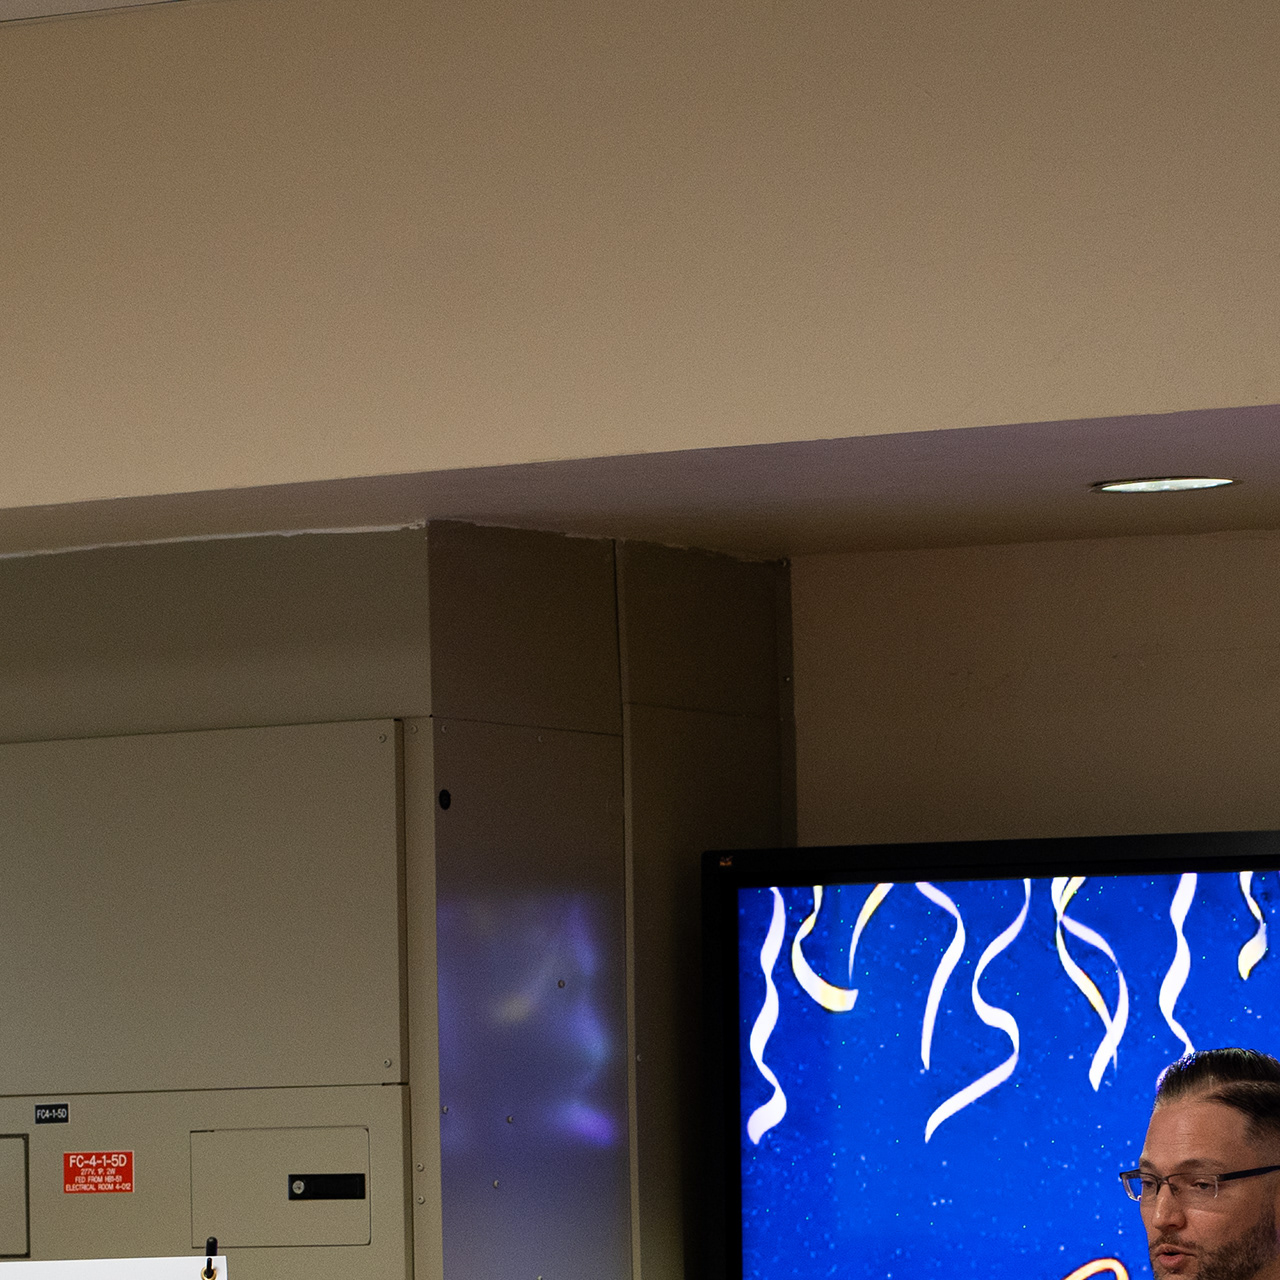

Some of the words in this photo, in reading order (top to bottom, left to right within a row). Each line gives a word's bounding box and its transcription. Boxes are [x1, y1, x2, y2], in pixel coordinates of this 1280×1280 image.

[36, 1108, 67, 1119] FC4-1-5D
[69, 1154, 127, 1168] FC-4-1-5D
[88, 1175, 103, 1183] FROM
[65, 1184, 96, 1192] ELECTRICAL
[98, 1183, 114, 1191] ROOM
